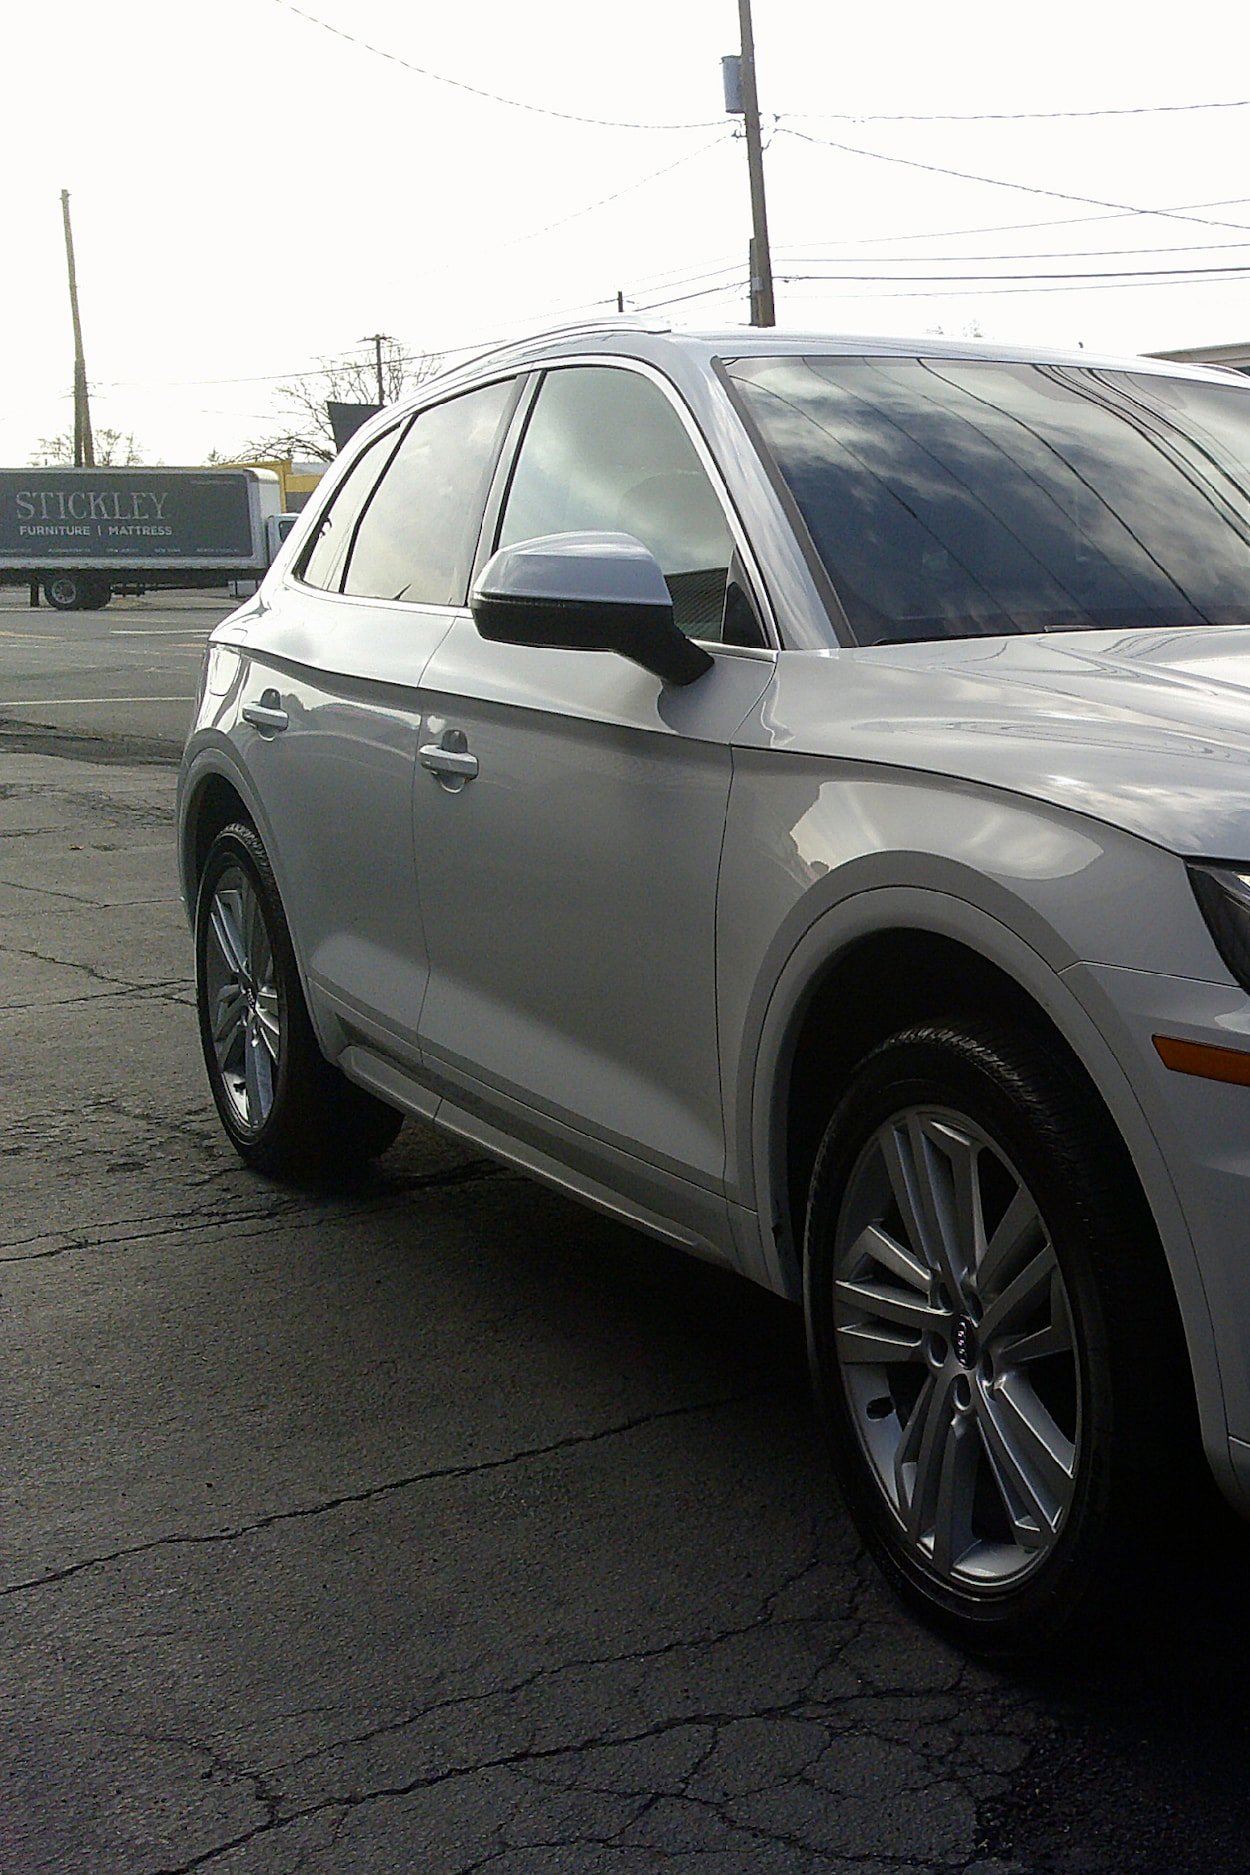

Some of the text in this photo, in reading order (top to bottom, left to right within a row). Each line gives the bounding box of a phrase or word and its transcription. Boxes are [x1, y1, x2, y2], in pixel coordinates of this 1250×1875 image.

[15, 491, 169, 520] STICKLEY
[19, 525, 173, 536] FURNITURE MATTRESS
